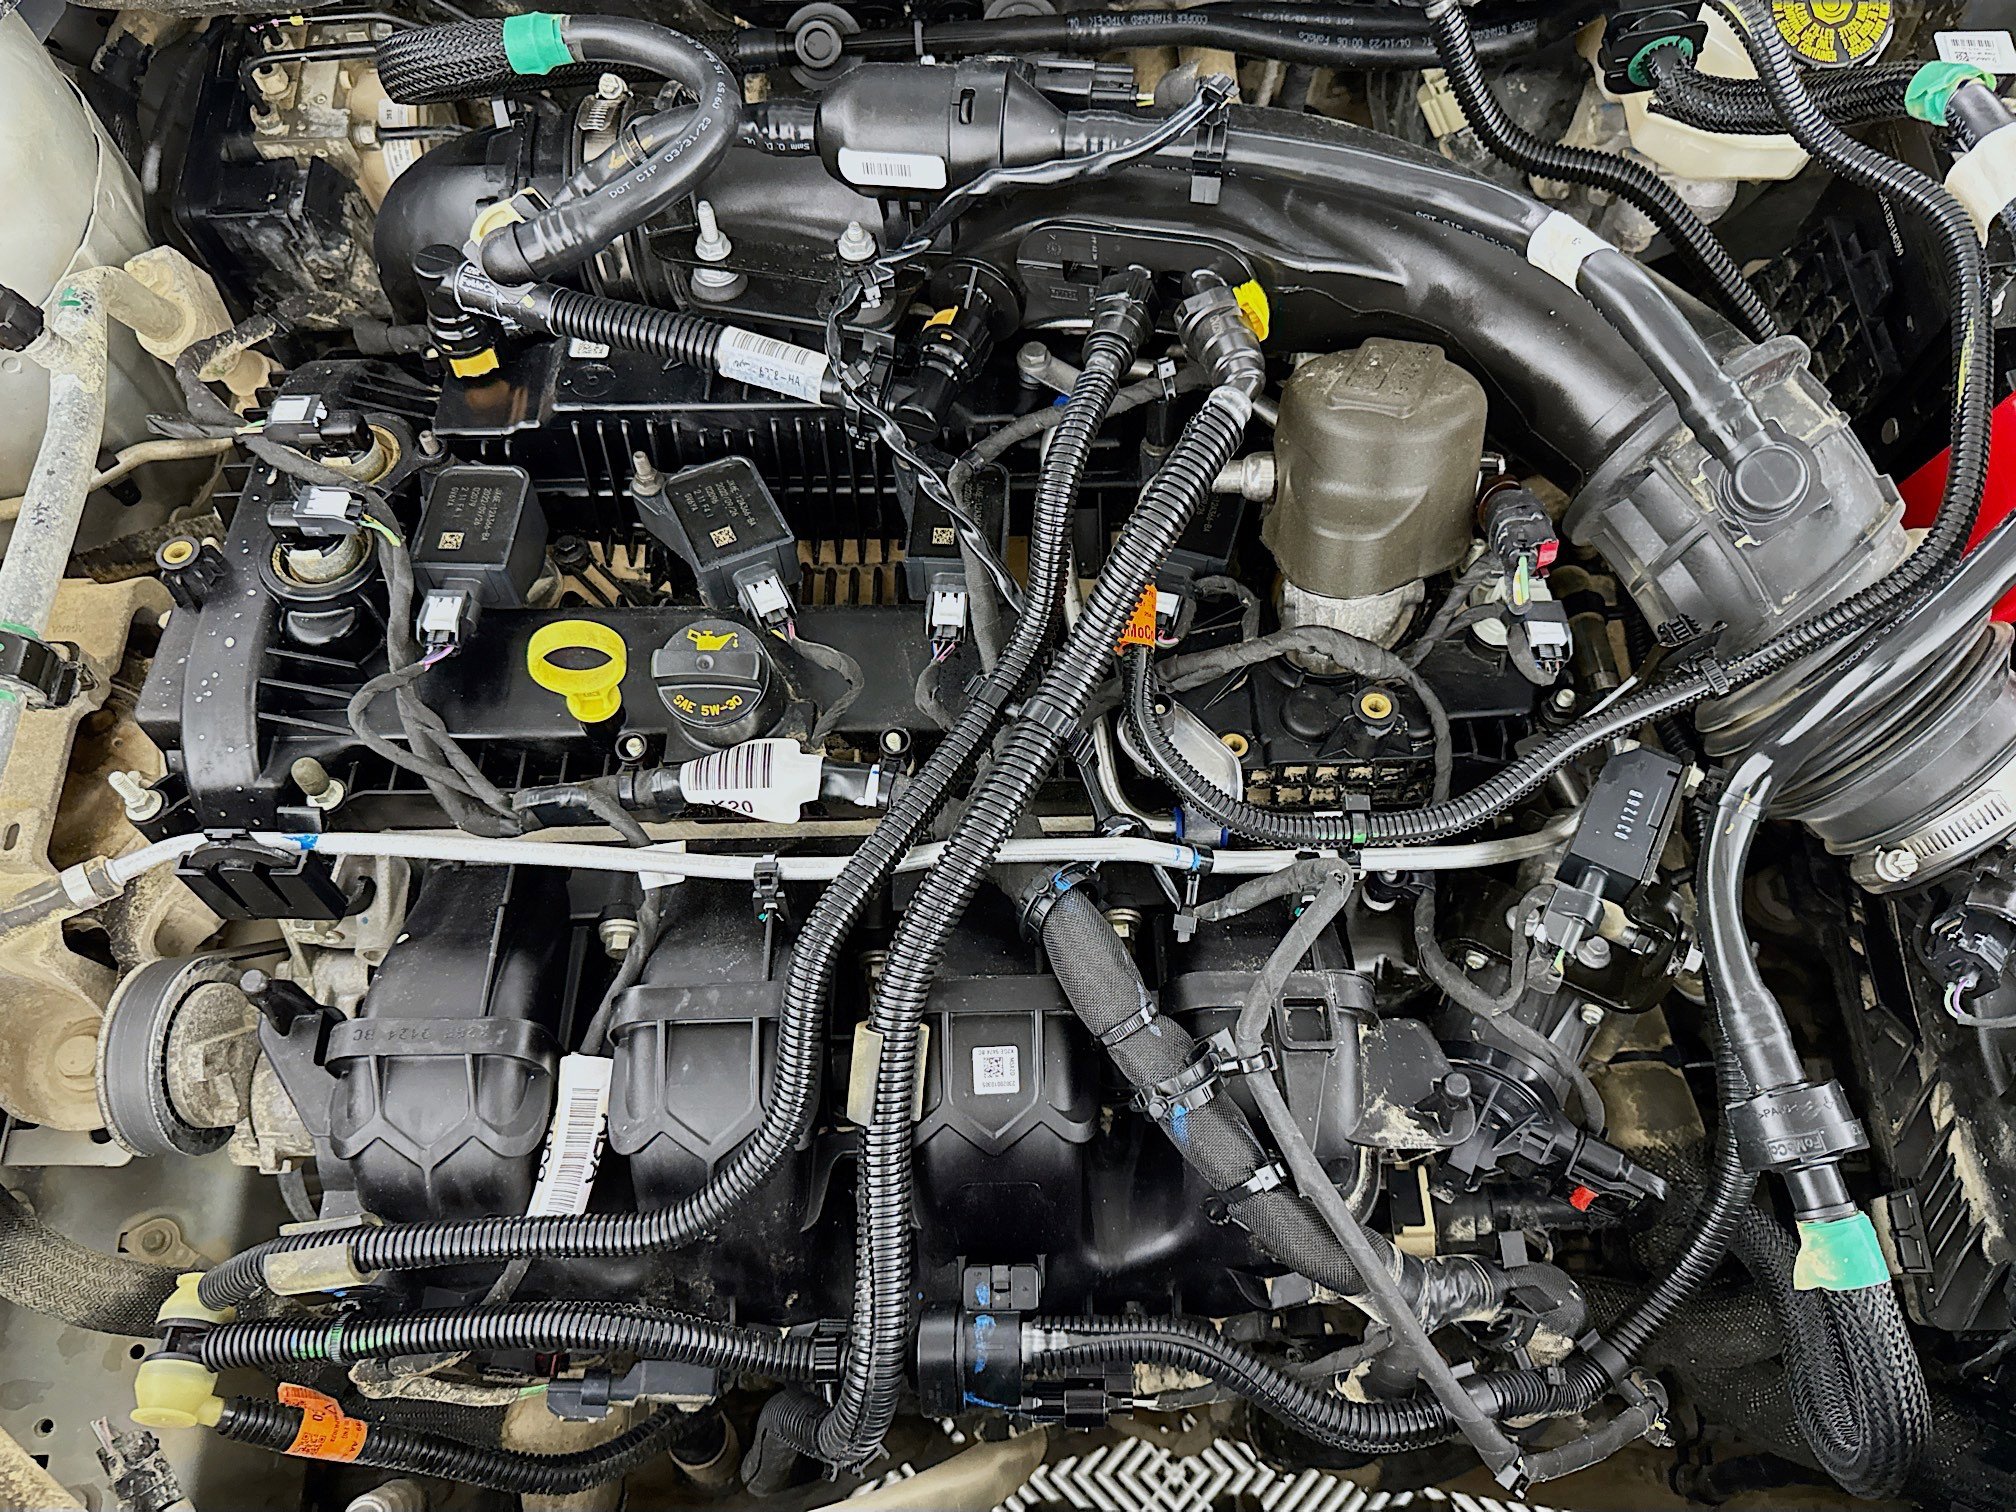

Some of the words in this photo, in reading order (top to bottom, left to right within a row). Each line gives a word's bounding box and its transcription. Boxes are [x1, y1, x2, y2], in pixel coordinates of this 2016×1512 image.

[608, 182, 631, 199] DOT
[636, 164, 658, 183] CIP
[664, 116, 712, 163] 03/31/23
[1838, 638, 1878, 670] COOPER
[672, 694, 697, 714] SAE
[701, 695, 743, 716] 5W-30
